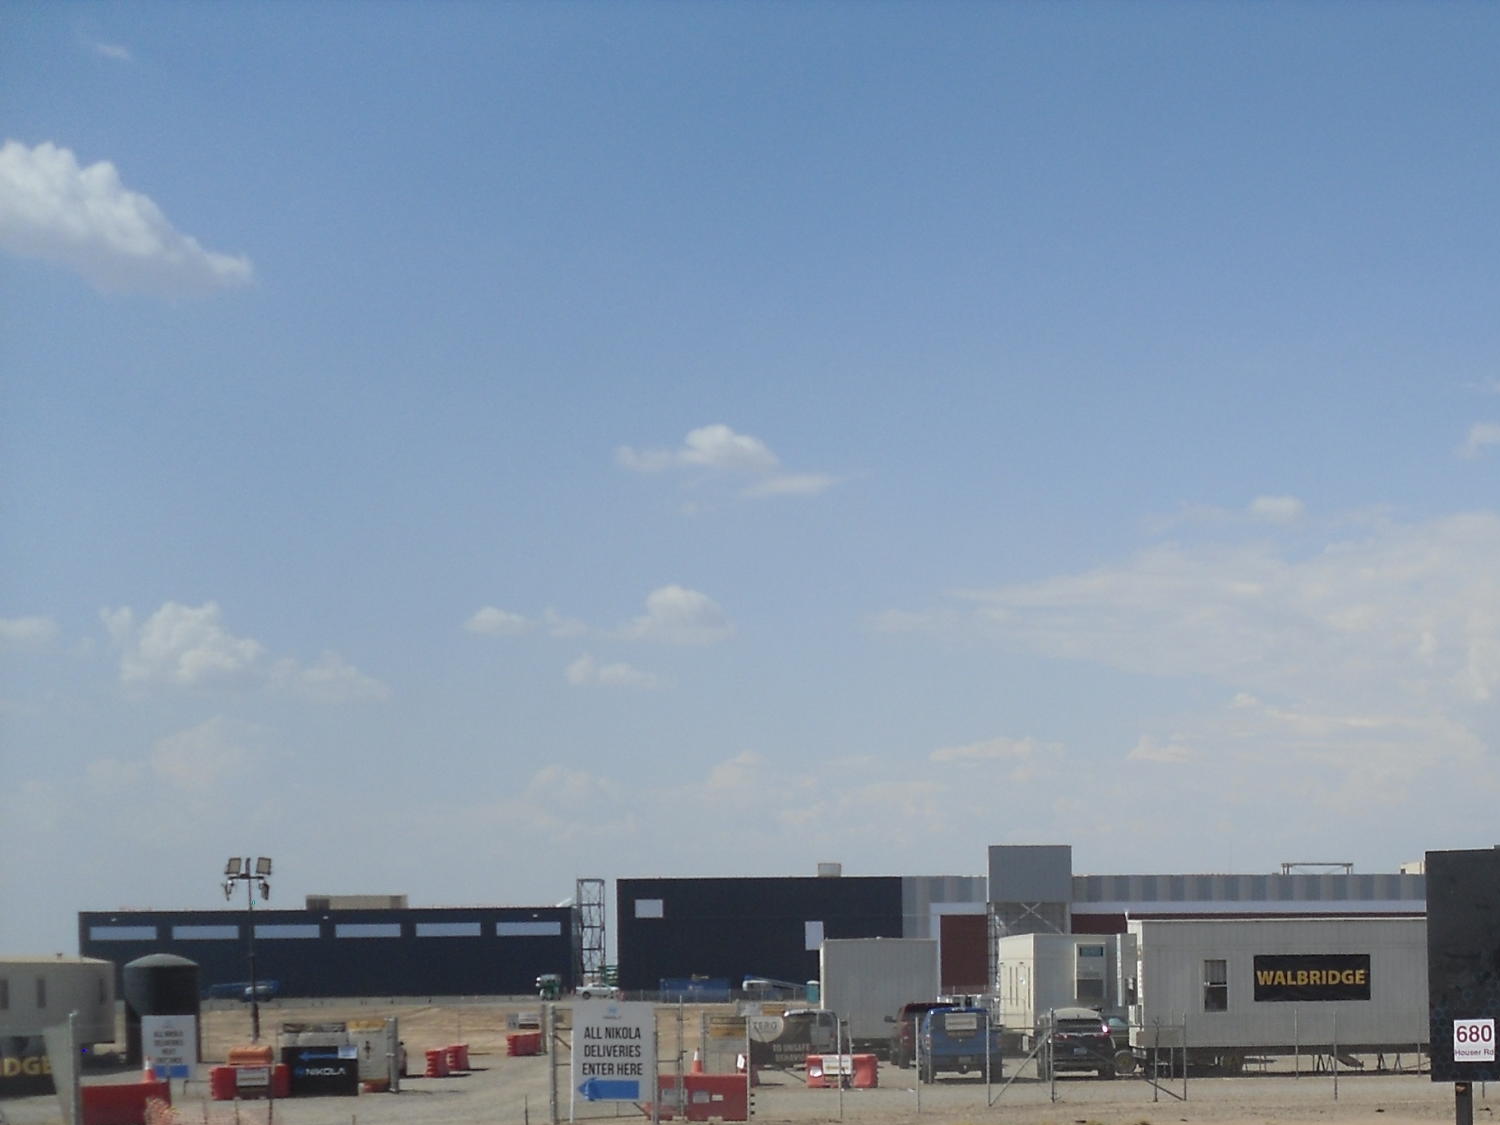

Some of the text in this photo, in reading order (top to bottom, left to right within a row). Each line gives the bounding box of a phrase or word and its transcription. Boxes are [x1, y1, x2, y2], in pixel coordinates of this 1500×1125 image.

[1256, 970, 1365, 985] WALBRIDGE
[584, 1027, 641, 1040] ALL NIKOLA
[1456, 1025, 1492, 1043] 680
[584, 1045, 641, 1058] DELIVERIES
[582, 1063, 643, 1076] ENTER HERE
